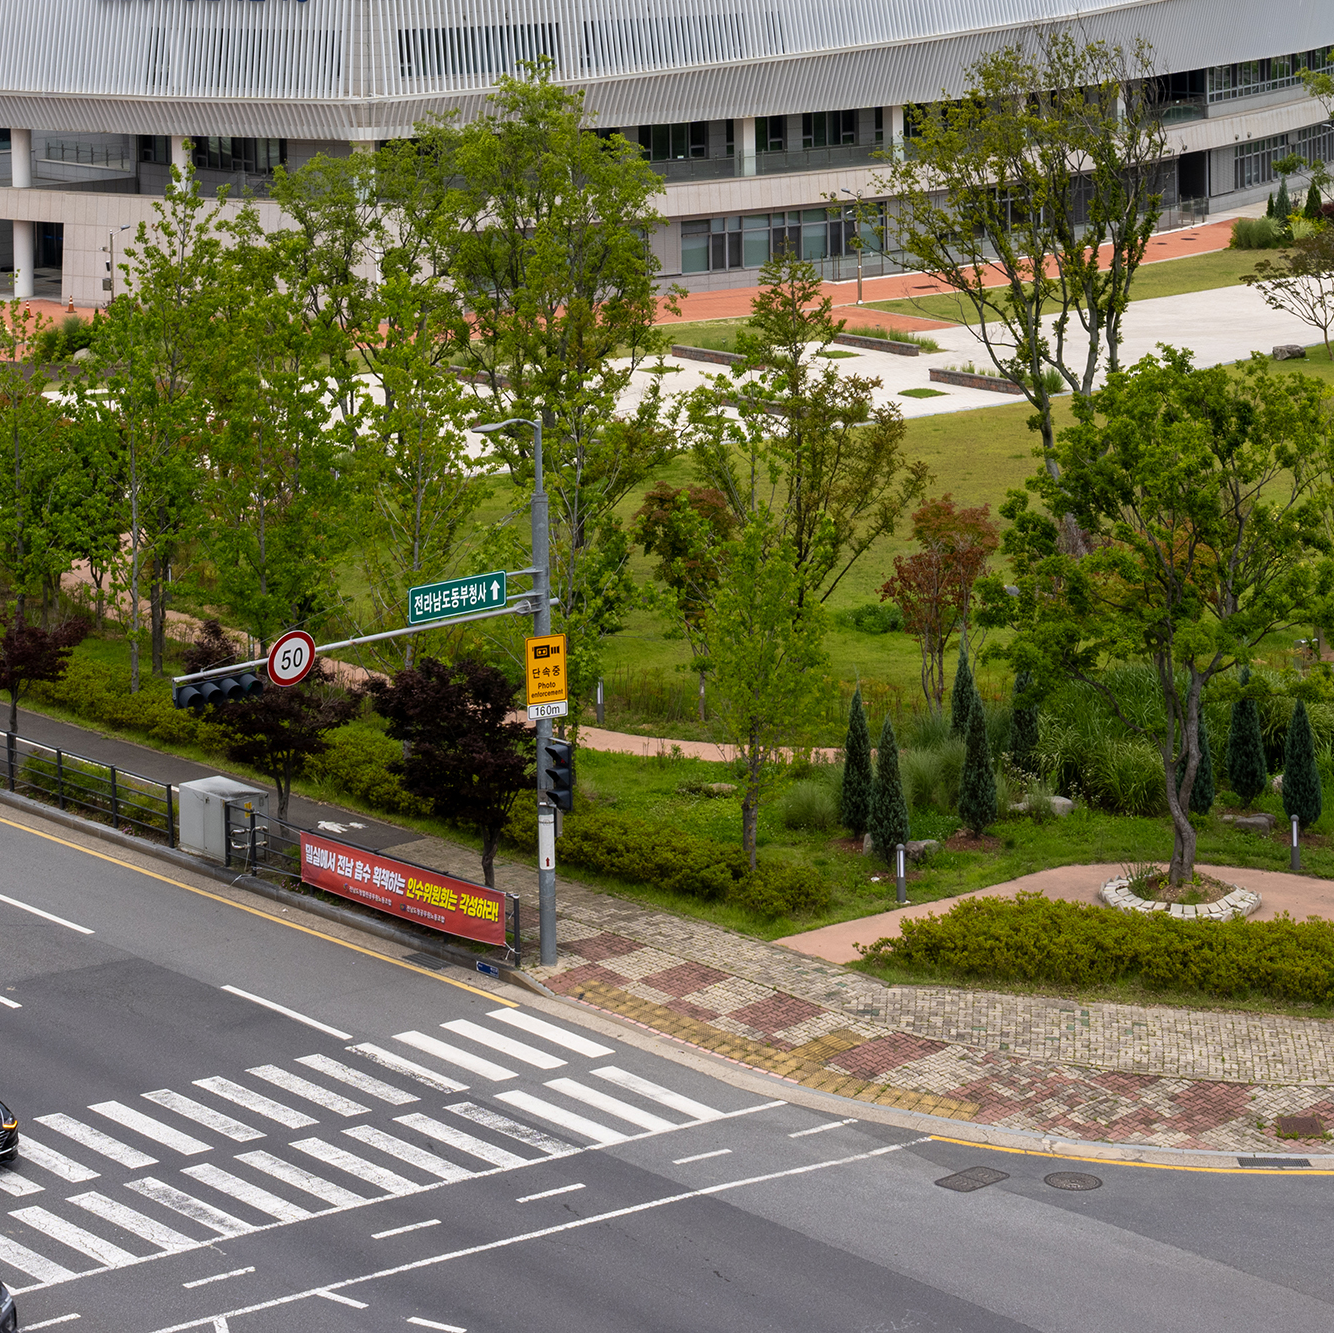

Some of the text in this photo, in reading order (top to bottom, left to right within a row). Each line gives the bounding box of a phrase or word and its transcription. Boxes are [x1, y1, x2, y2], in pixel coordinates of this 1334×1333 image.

[414, 581, 487, 616] 전라남도동부청사
[281, 647, 303, 670] 50
[532, 665, 560, 679] 단속중
[537, 681, 556, 689] Photo
[531, 688, 564, 698] enforcement
[535, 705, 560, 716] 160m
[305, 843, 499, 922] 밀실에서 전남 흡수 획책하는 인수위원회는 각성하라!
